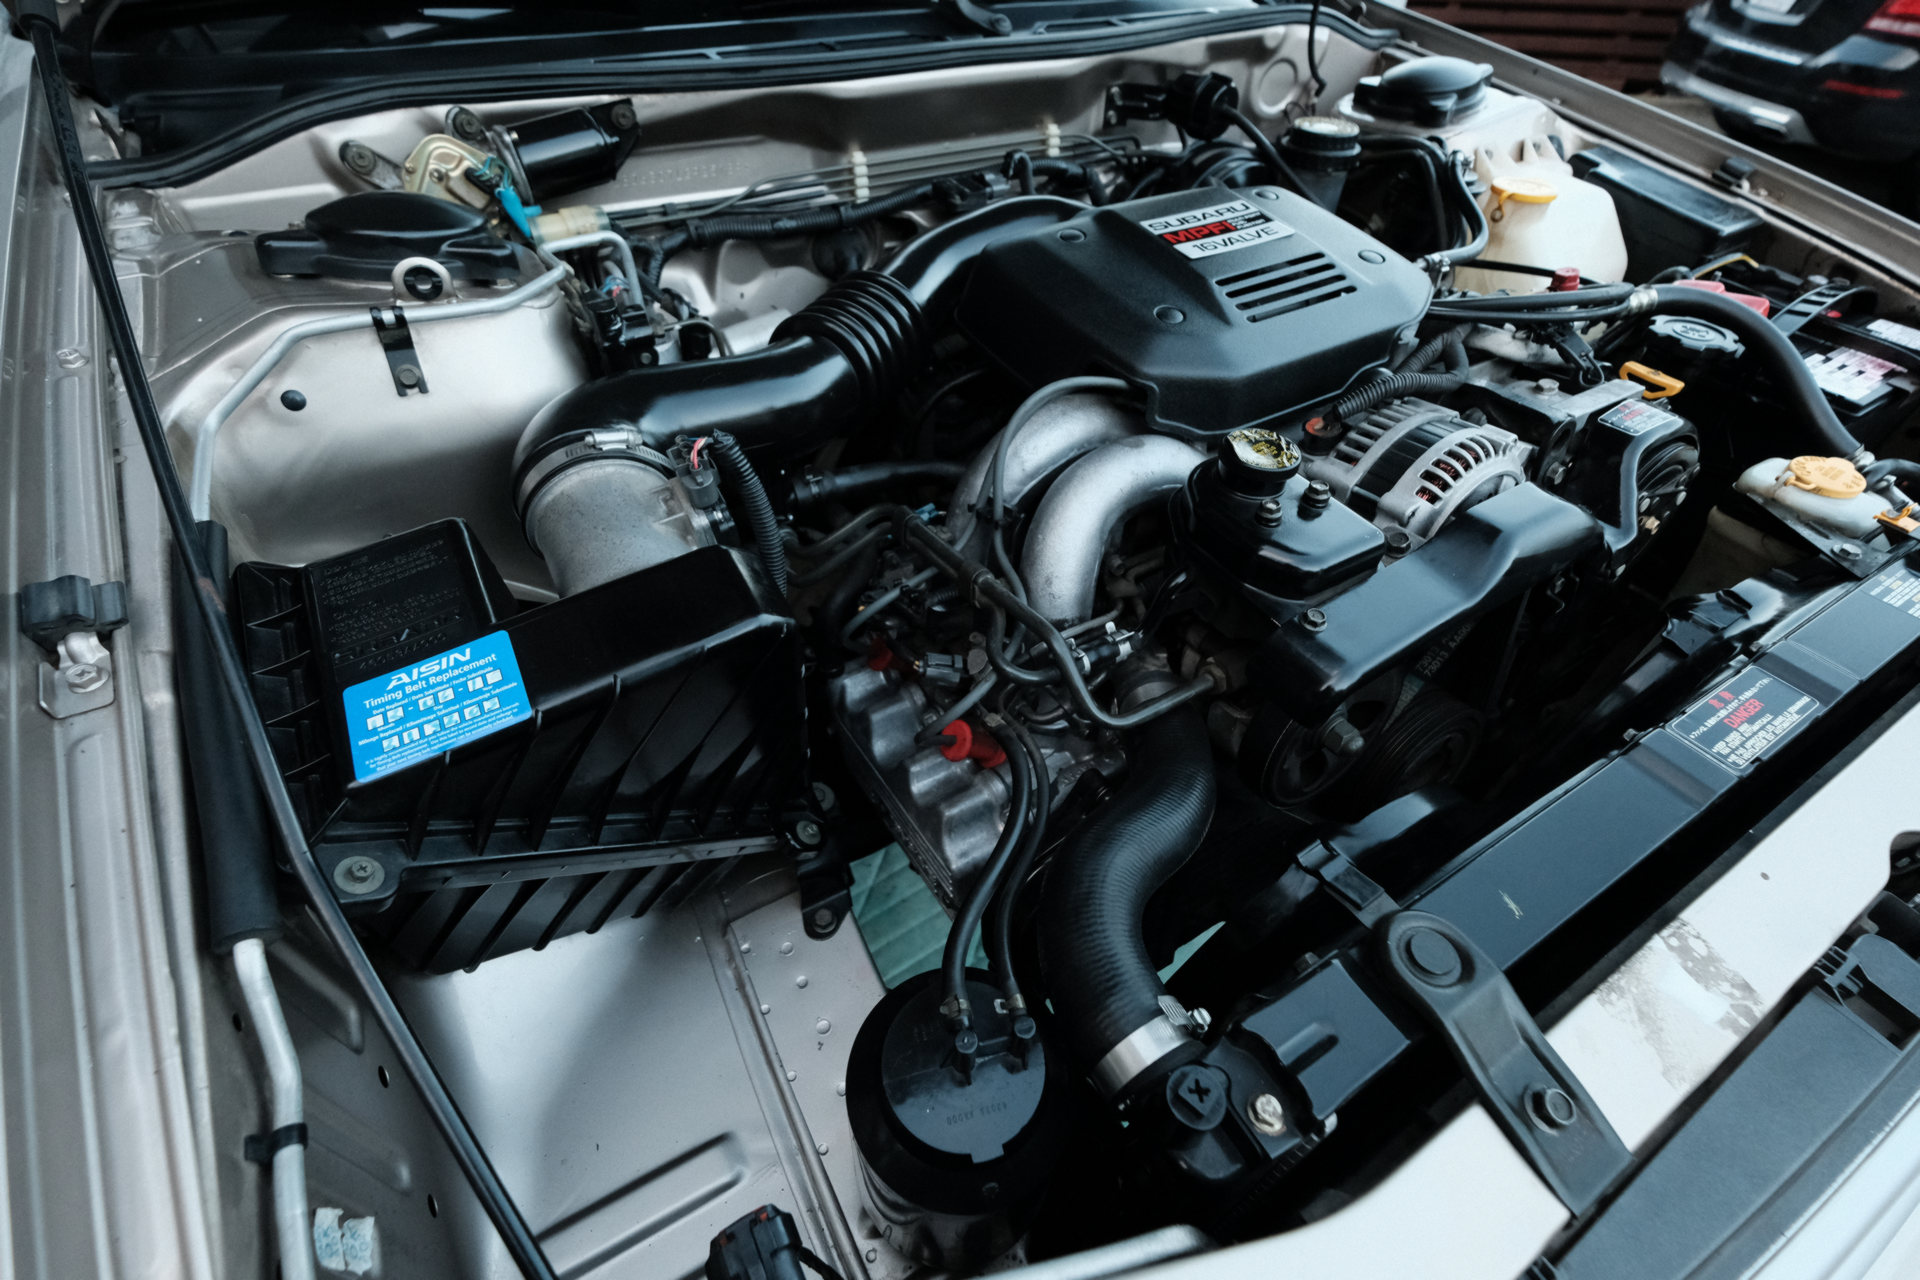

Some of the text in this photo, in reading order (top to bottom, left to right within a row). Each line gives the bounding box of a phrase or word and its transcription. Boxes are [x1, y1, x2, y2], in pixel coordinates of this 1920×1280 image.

[1148, 203, 1250, 231] SUBARU
[1162, 220, 1238, 245] MPFI
[1192, 226, 1277, 252] 16VALVE
[364, 653, 497, 709] Timing Belt Replacement
[385, 648, 471, 690] AISIN
[1724, 698, 1764, 728] DANGER
